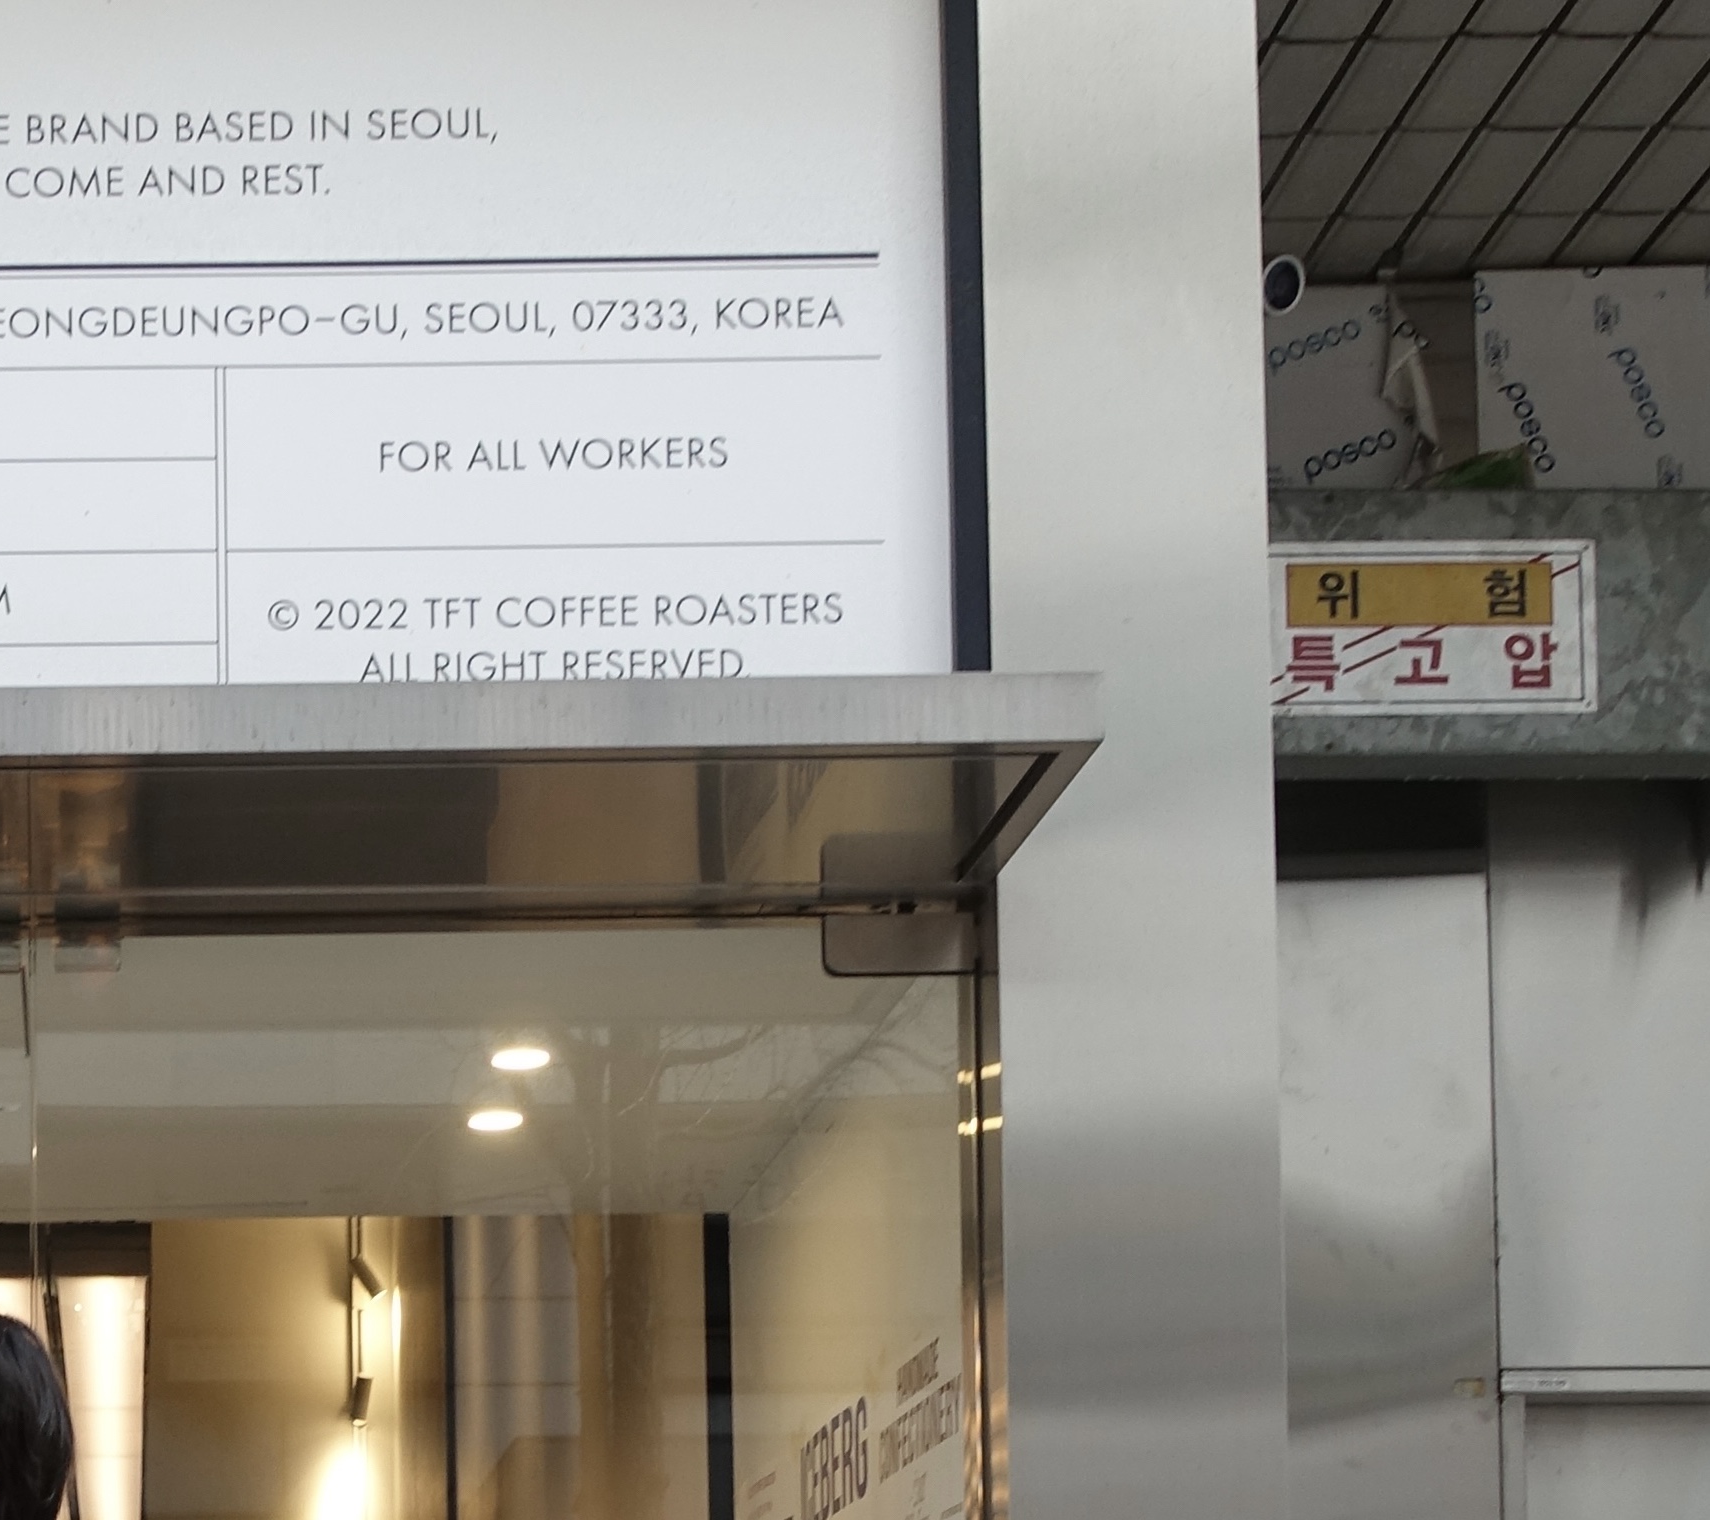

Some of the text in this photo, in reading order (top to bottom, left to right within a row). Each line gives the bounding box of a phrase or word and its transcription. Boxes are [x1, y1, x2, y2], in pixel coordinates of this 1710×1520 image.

[26, 111, 159, 146] BRAND
[175, 109, 294, 144] BASED
[310, 108, 350, 142] IN
[366, 106, 498, 145] SEOUL,
[4, 165, 124, 200] COME
[137, 164, 226, 198] AND
[241, 163, 331, 196] REST.
[423, 300, 557, 339] SEOUL,
[571, 297, 699, 337] 07333,
[715, 295, 845, 331] KOREA
[1269, 319, 1361, 375] posco
[1607, 347, 1665, 439] posco
[1497, 382, 1555, 473] posco
[379, 435, 729, 474] FOR ALL WORKERS
[1305, 428, 1396, 484] posco
[314, 597, 409, 631] 2022
[422, 596, 483, 630] TFT
[495, 594, 639, 629] COFFEE
[654, 591, 844, 627] ROASTERS
[359, 651, 418, 682] ALL
[433, 650, 547, 681] RIGHT
